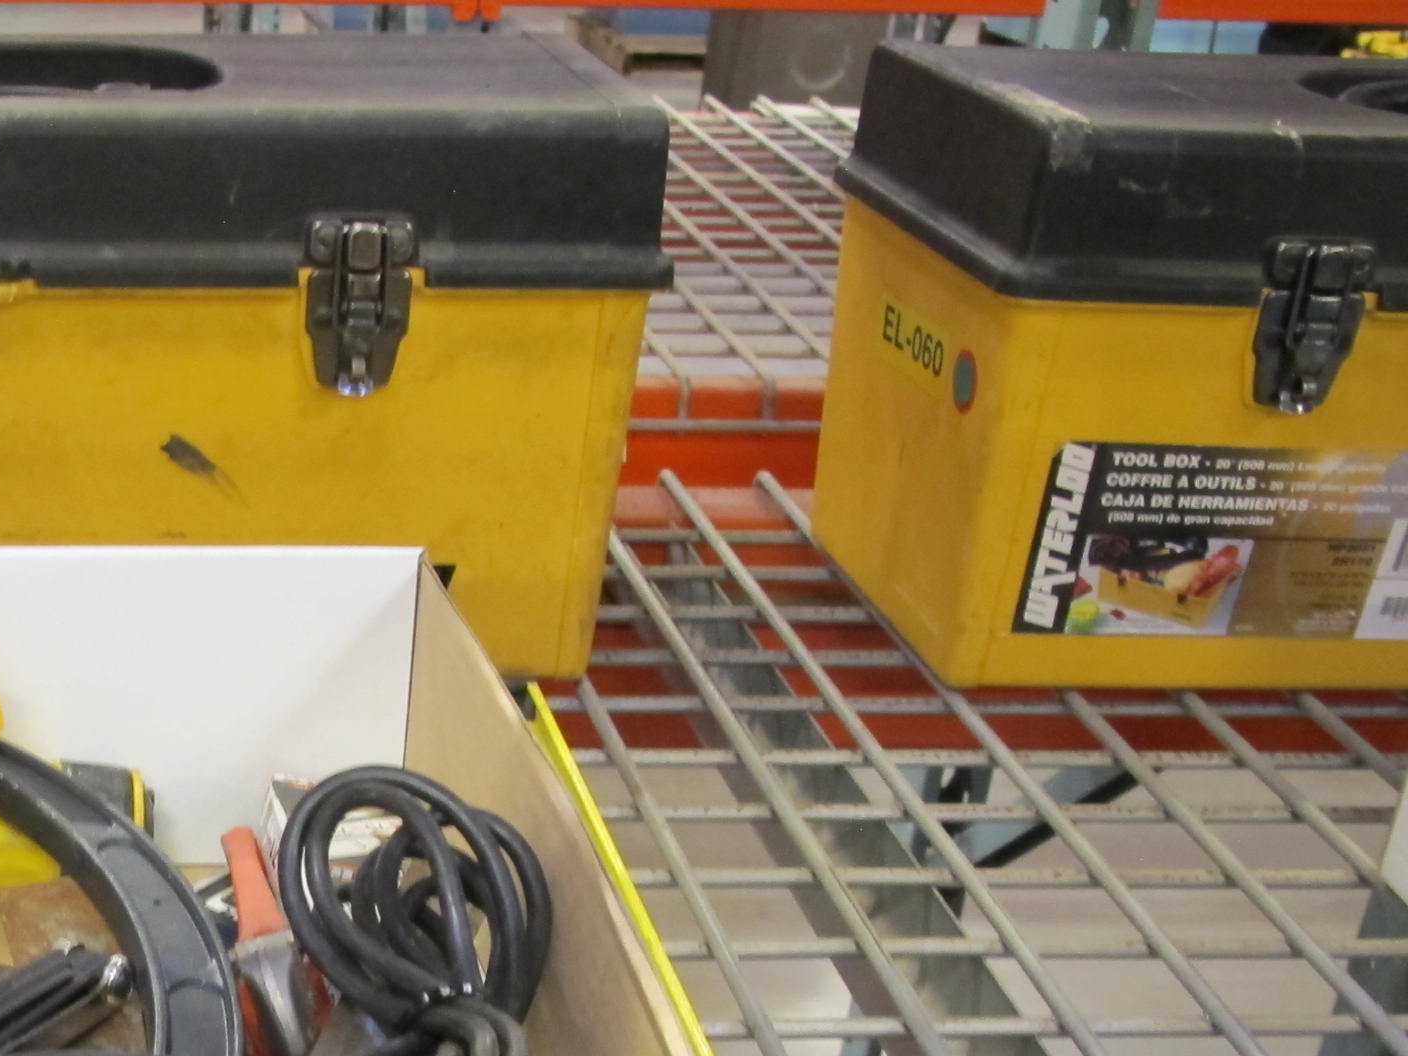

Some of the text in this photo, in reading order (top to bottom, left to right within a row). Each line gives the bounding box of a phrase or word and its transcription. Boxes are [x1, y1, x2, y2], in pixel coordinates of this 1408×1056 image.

[883, 303, 944, 377] EL-060
[1112, 452, 1158, 468] TOOL
[1163, 453, 1201, 469] BOX
[1106, 472, 1174, 488] COFFRE
[1194, 475, 1256, 491] OUTILS
[1101, 493, 1145, 508] CAJA
[1151, 493, 1173, 508] DE
[1179, 495, 1310, 512] HERRAMIENTAS
[1167, 513, 1181, 525] de
[1184, 515, 1210, 527] gran
[1213, 514, 1275, 528] capacidad
